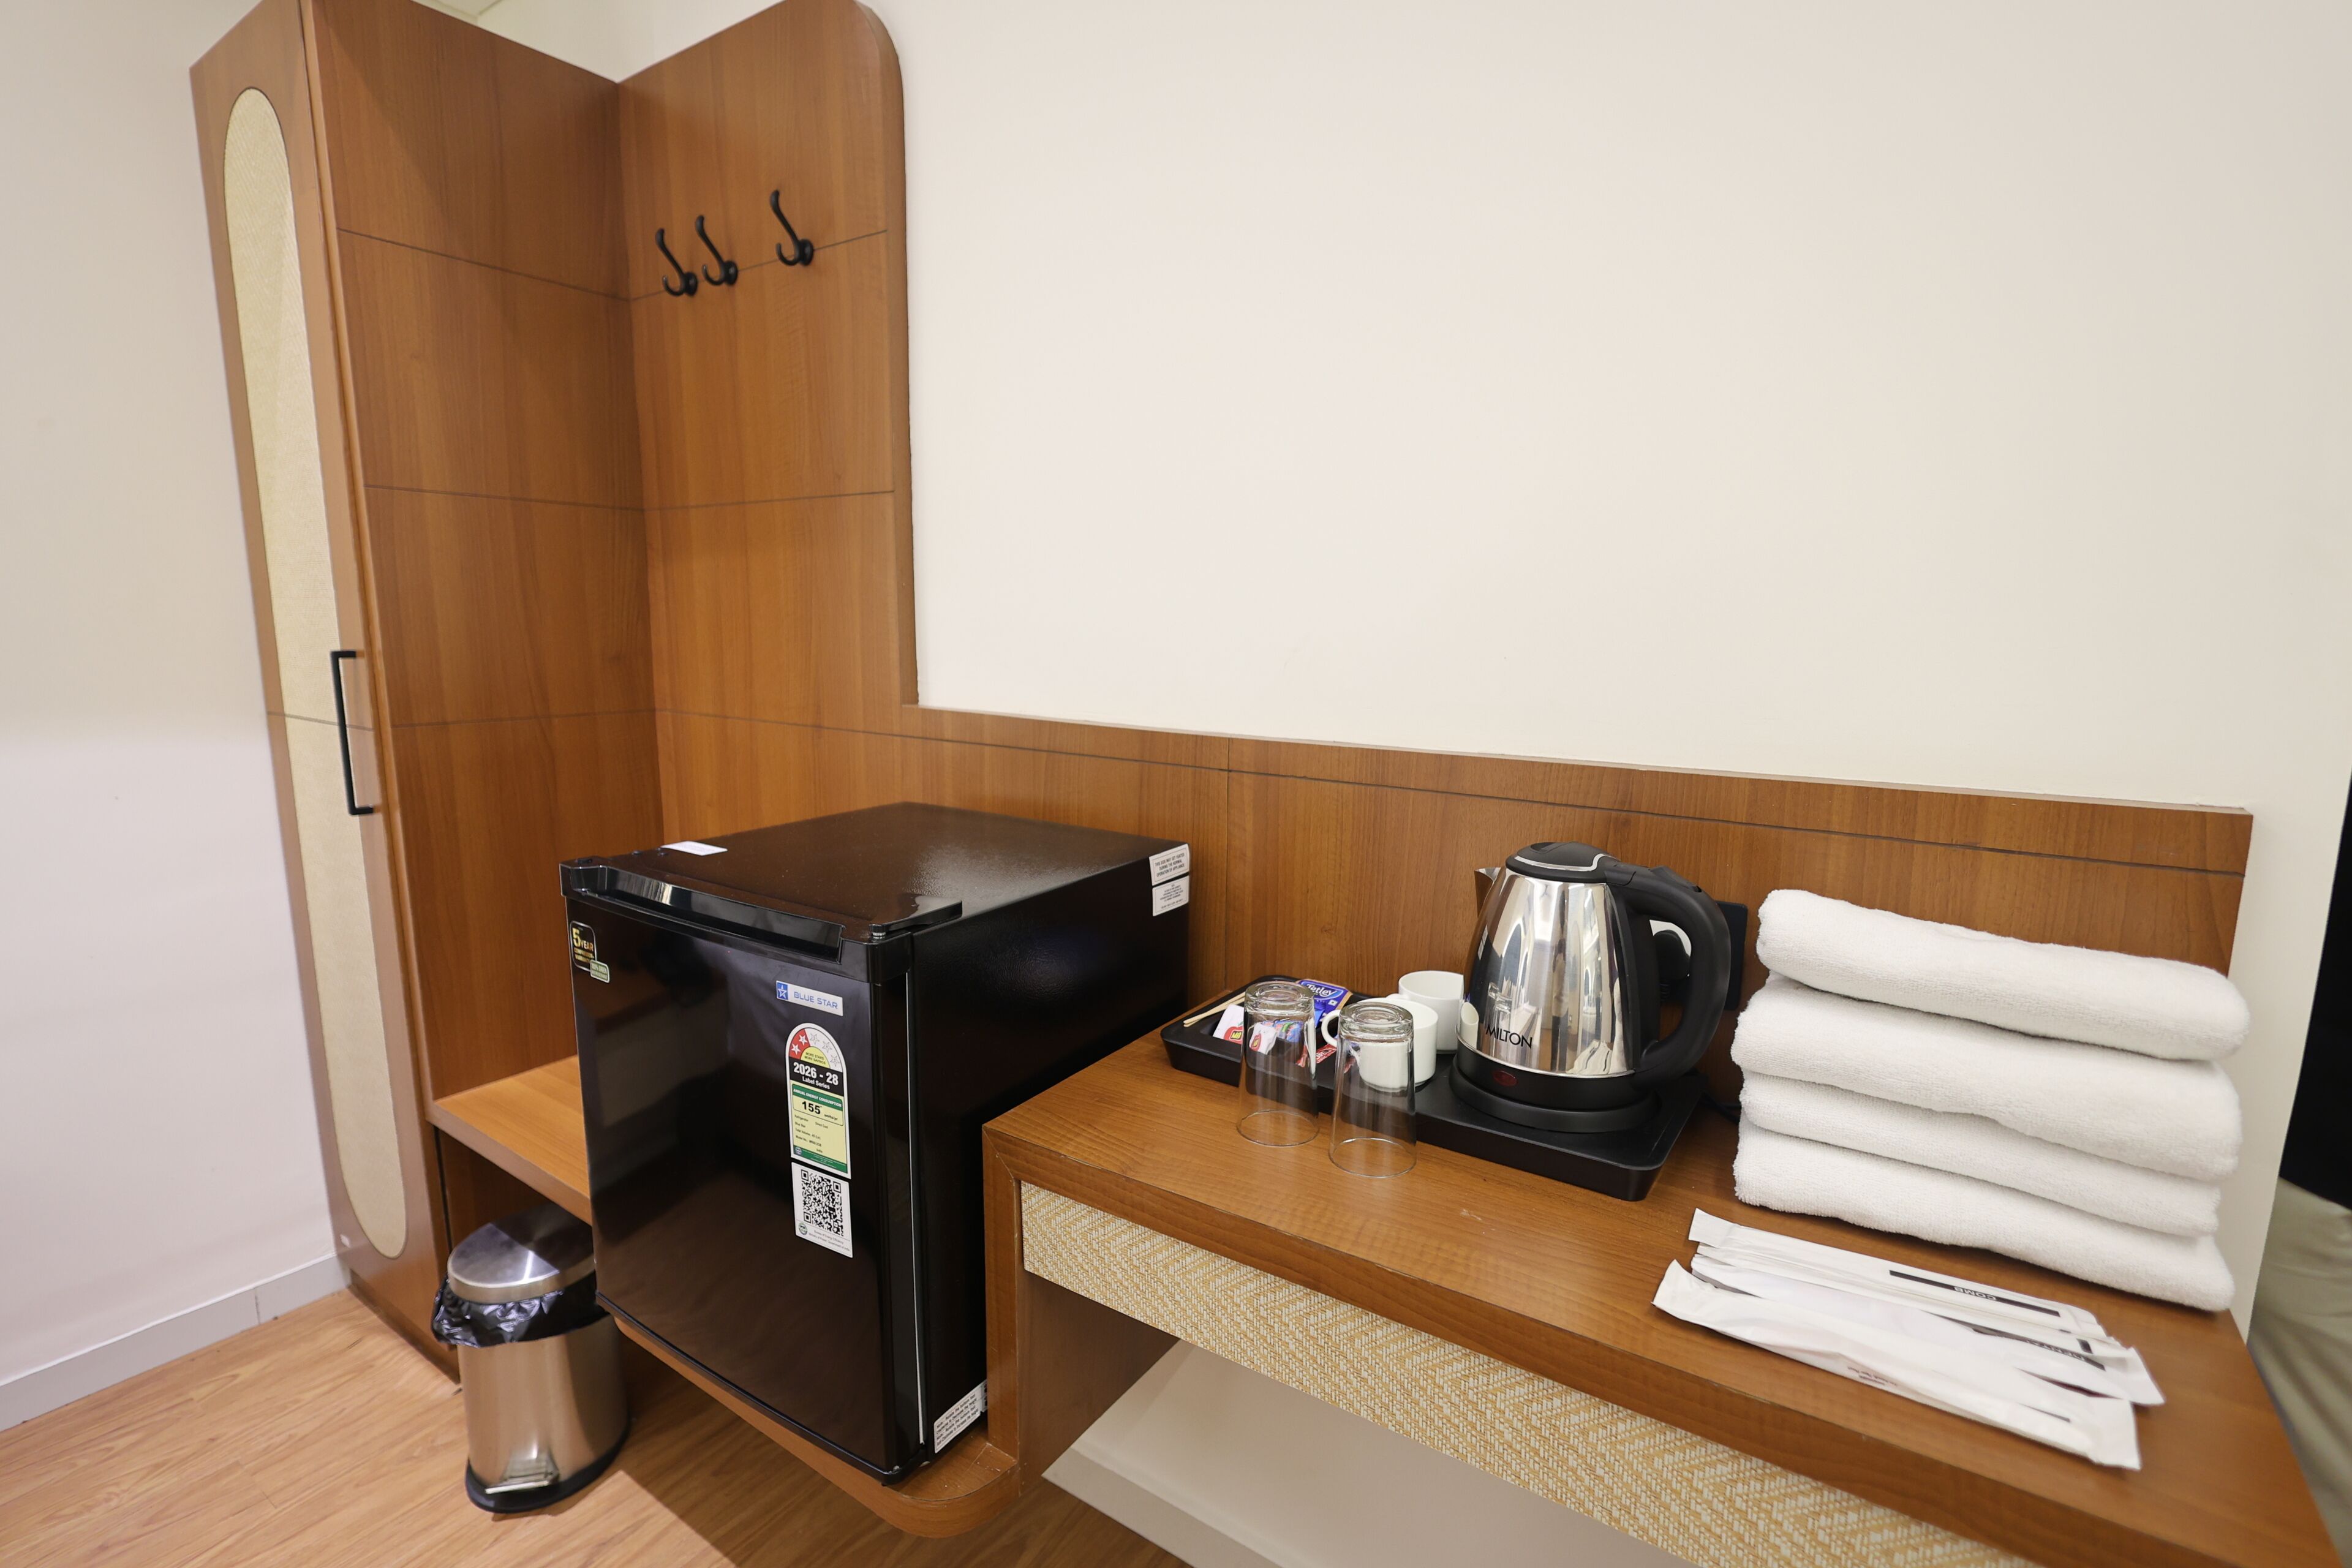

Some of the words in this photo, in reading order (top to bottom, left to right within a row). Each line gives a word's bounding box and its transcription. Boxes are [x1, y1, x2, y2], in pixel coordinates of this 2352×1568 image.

[1306, 984, 1337, 997] Tetley
[794, 992, 814, 1003] BLUE
[817, 998, 838, 1009] STAR
[1485, 1025, 1532, 1049] MILTON
[793, 1062, 816, 1079] 2026
[826, 1072, 839, 1085] 28
[816, 1080, 830, 1089] Series
[1953, 1286, 1997, 1301] COMB
